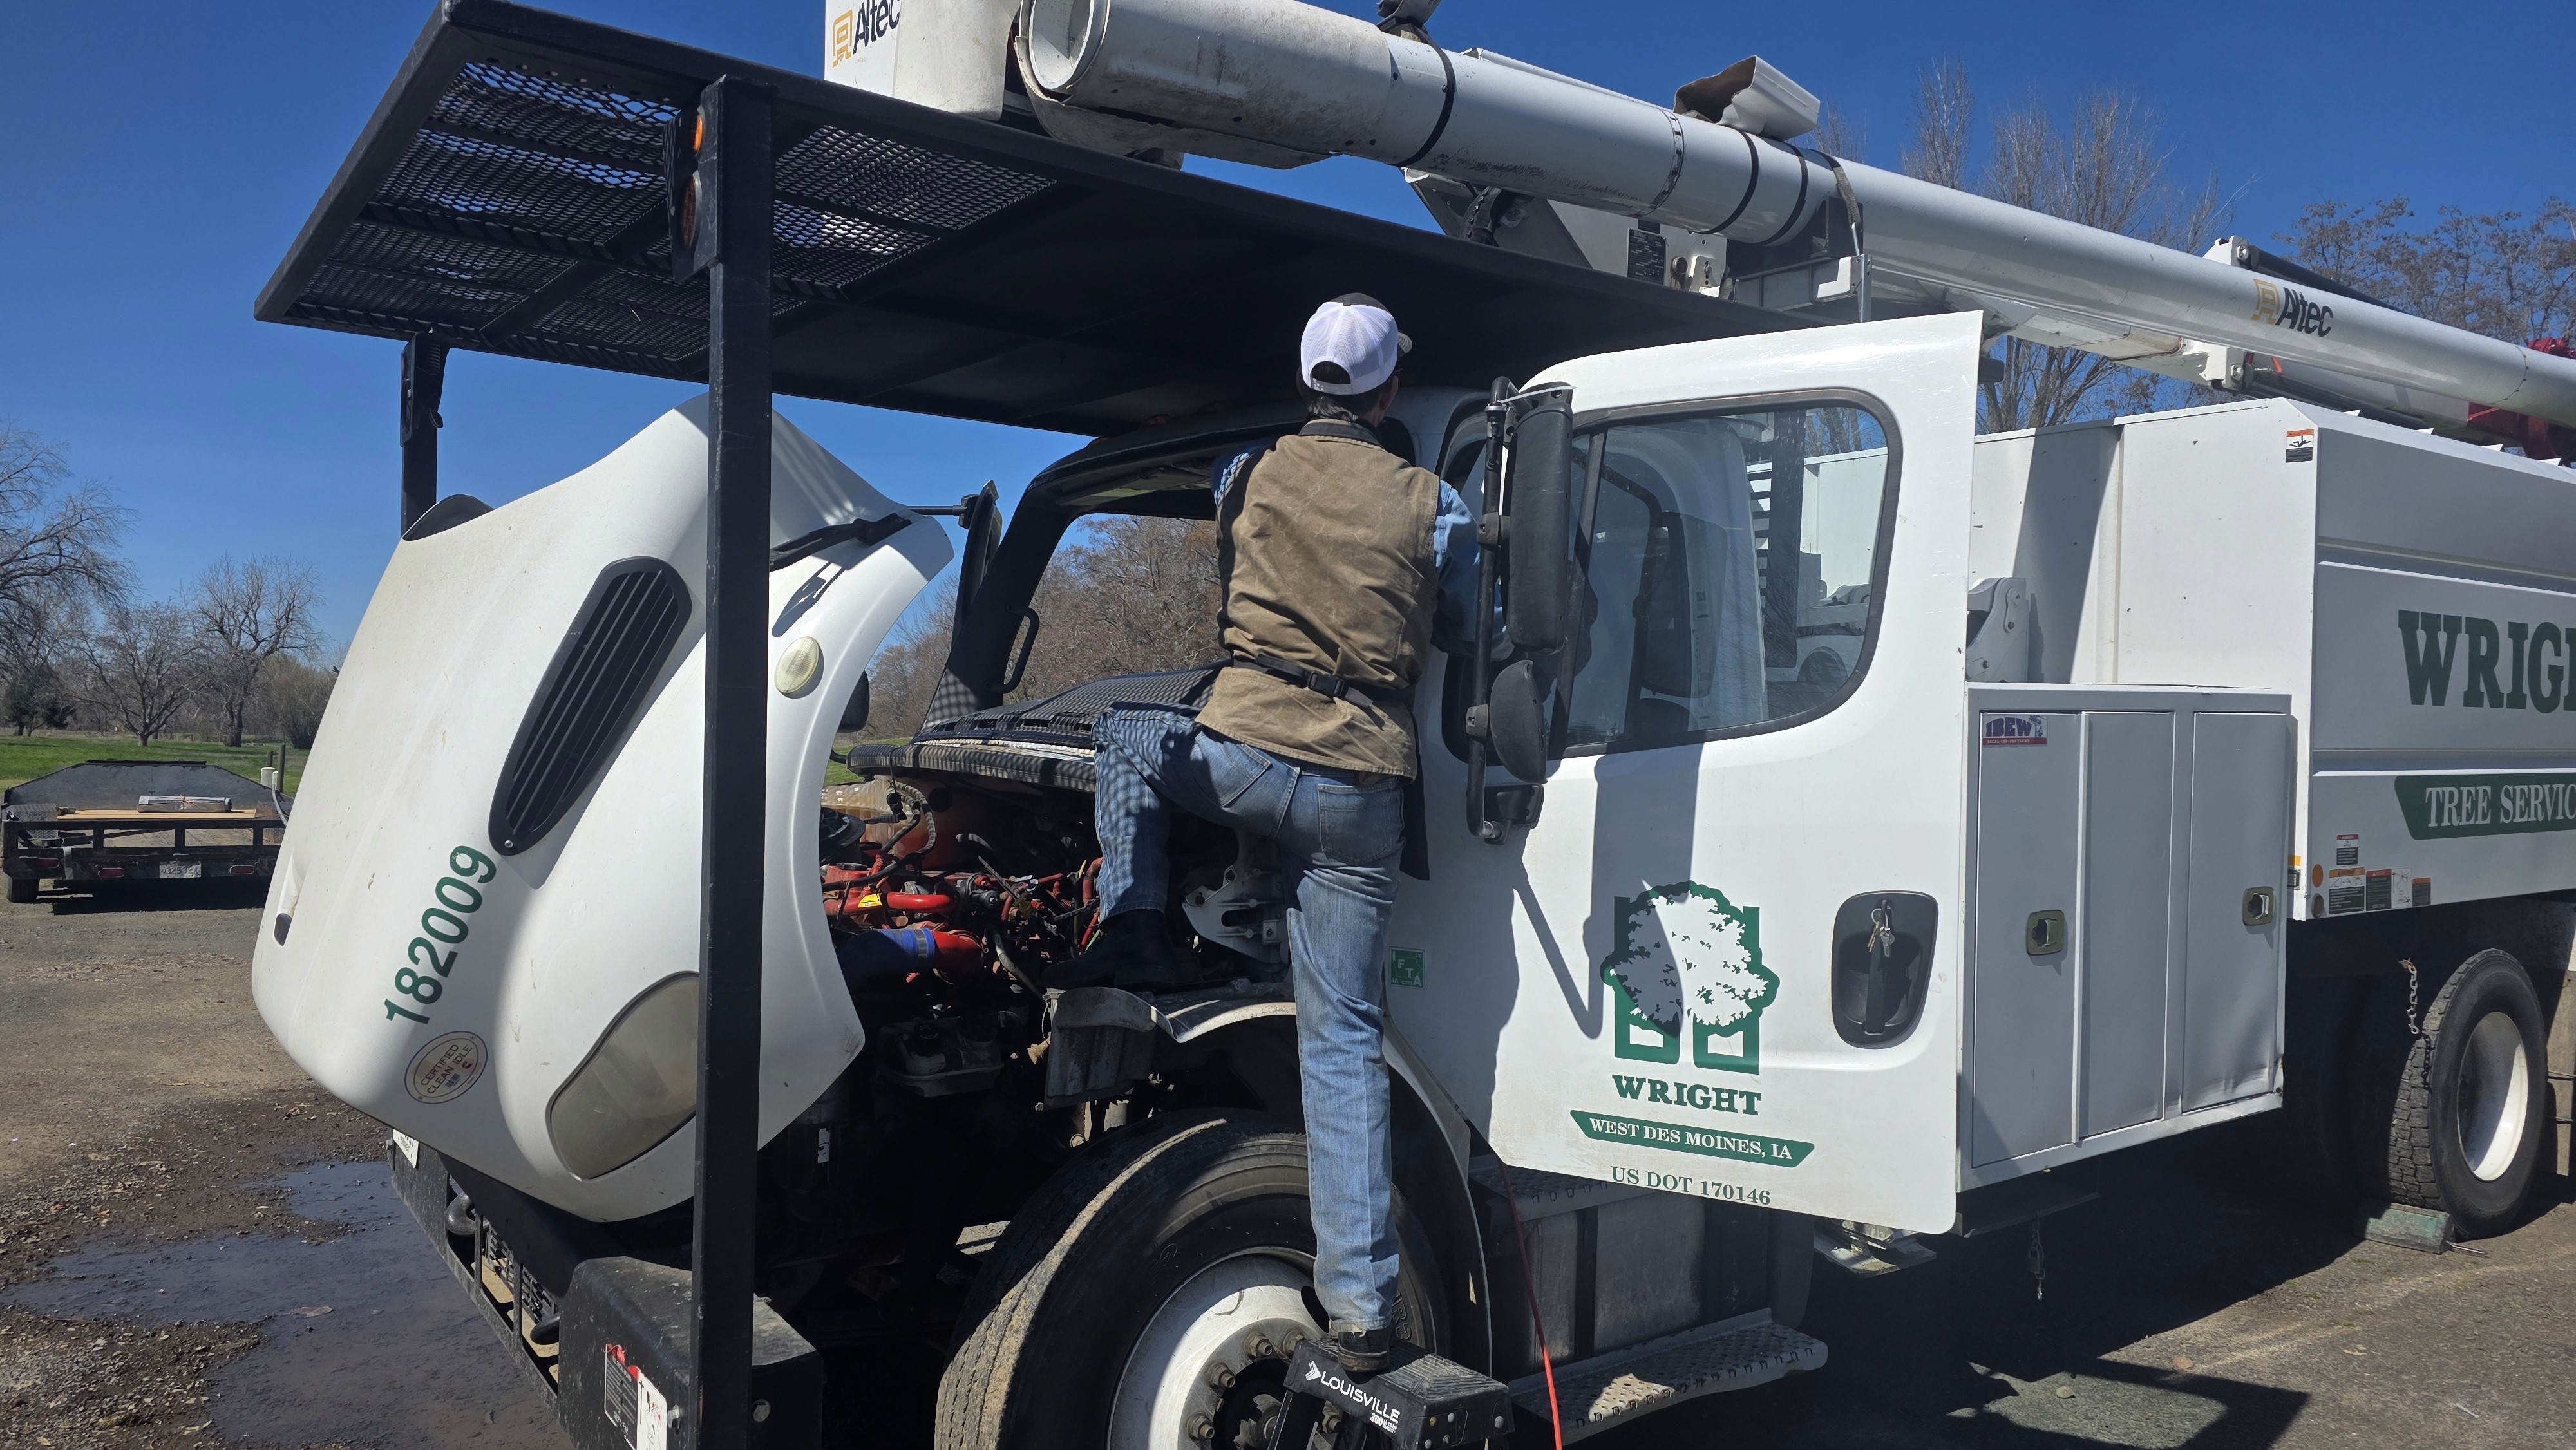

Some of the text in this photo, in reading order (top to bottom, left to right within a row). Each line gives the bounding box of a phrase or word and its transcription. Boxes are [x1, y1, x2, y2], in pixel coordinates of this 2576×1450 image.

[853, 0, 900, 55] Altec
[2275, 287, 2334, 337] Altec
[1986, 717, 2032, 737] IBEW
[2425, 786, 2491, 827] TREE
[384, 845, 497, 1025] 182009
[421, 1044, 459, 1086] CERTIFIED
[427, 1066, 455, 1094] CLEAN
[452, 1044, 473, 1064] IDLE
[1612, 1074, 1762, 1116] WRIGHT
[1589, 1118, 1793, 1160] WEST DES MOINES, IA
[1610, 1165, 1771, 1205] US DOT 170146
[1320, 1370, 1401, 1424] LOUISVILLE
[1370, 1412, 1383, 1426] 300
